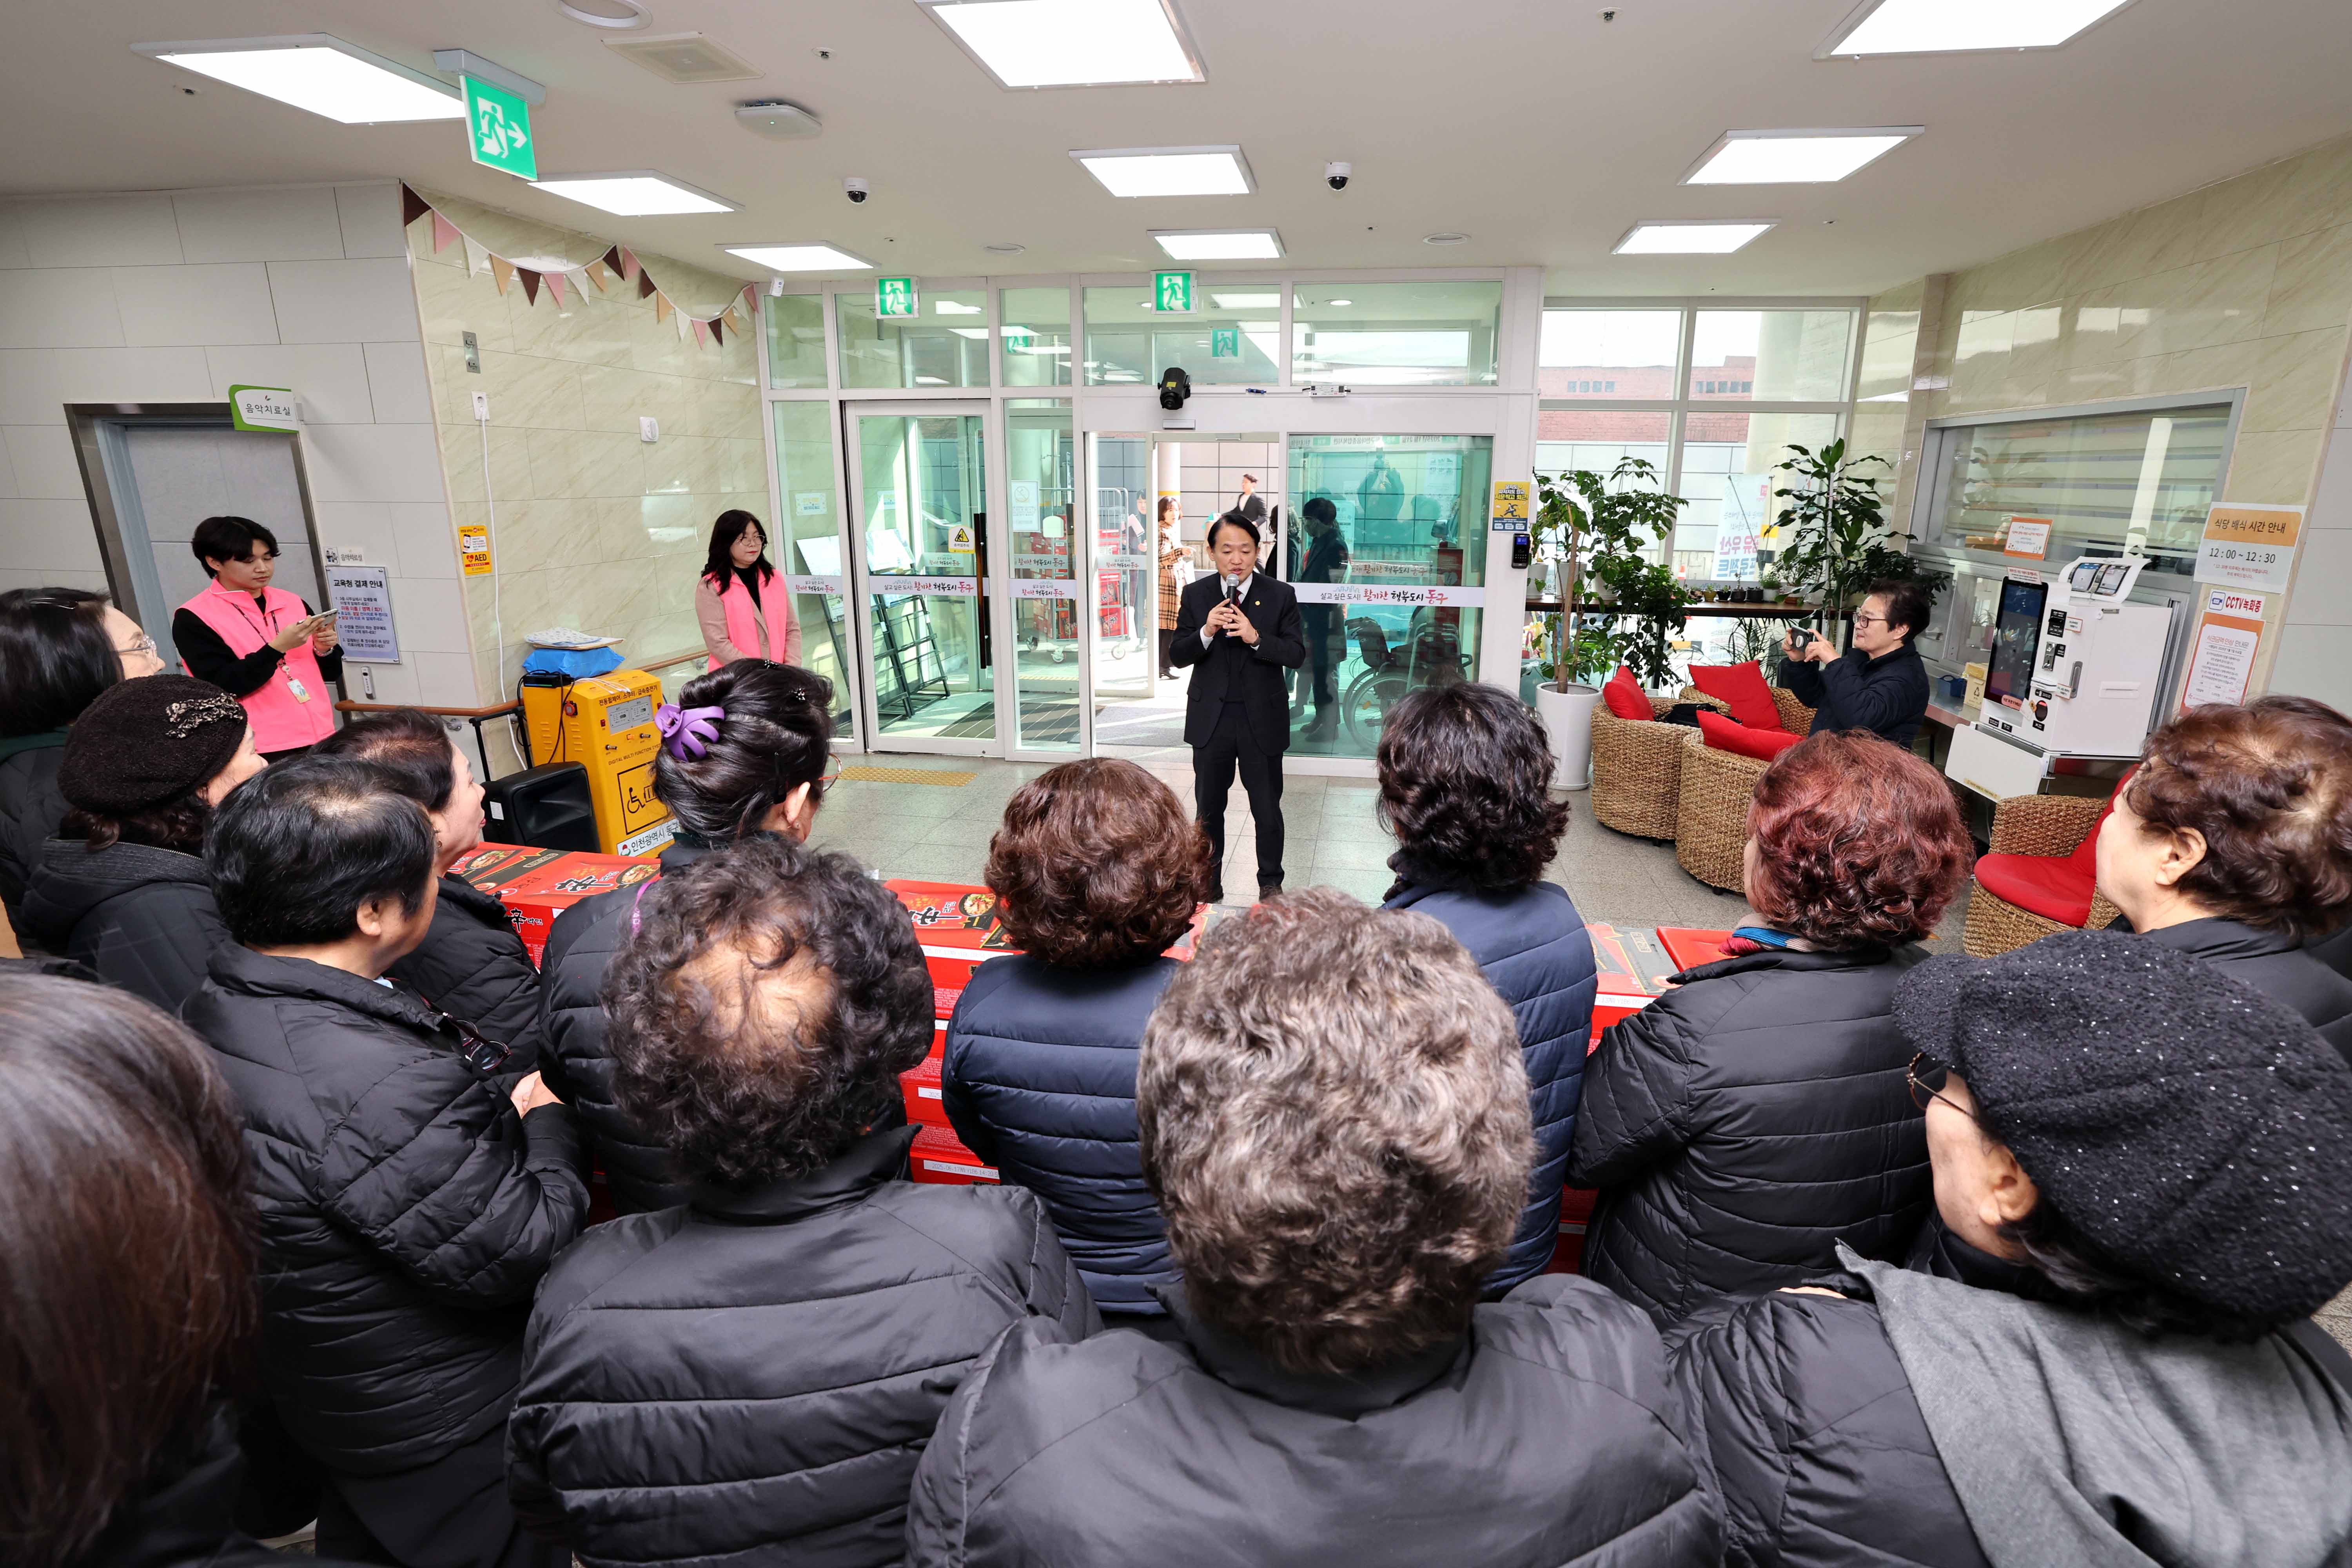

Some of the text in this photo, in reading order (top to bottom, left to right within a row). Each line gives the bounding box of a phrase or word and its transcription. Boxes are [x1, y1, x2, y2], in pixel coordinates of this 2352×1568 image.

[245, 403, 291, 416] 음악치료실
[2215, 519, 2286, 534] 식당 배식 시간 안내
[1053, 558, 1065, 567] 동구
[1384, 566, 1409, 574] 행복도시
[334, 579, 383, 588] 교육청 결제 안내
[914, 581, 932, 591] 활기찬
[933, 583, 956, 592] 행복도시
[958, 581, 974, 592] 동구
[1053, 589, 1064, 597] 동구
[1363, 589, 1388, 601] 활기찬
[1391, 590, 1423, 603] 행복도시
[1425, 589, 1448, 604] 동구
[2226, 596, 2261, 612] CCTV녹화중
[623, 691, 635, 699] 스쿠터
[637, 684, 658, 695] 급속충전기
[608, 755, 623, 765] DIGITAL
[623, 752, 634, 760] MULTI
[635, 746, 652, 756] FUNCTION
[632, 822, 679, 852] 인천광역시 동구
